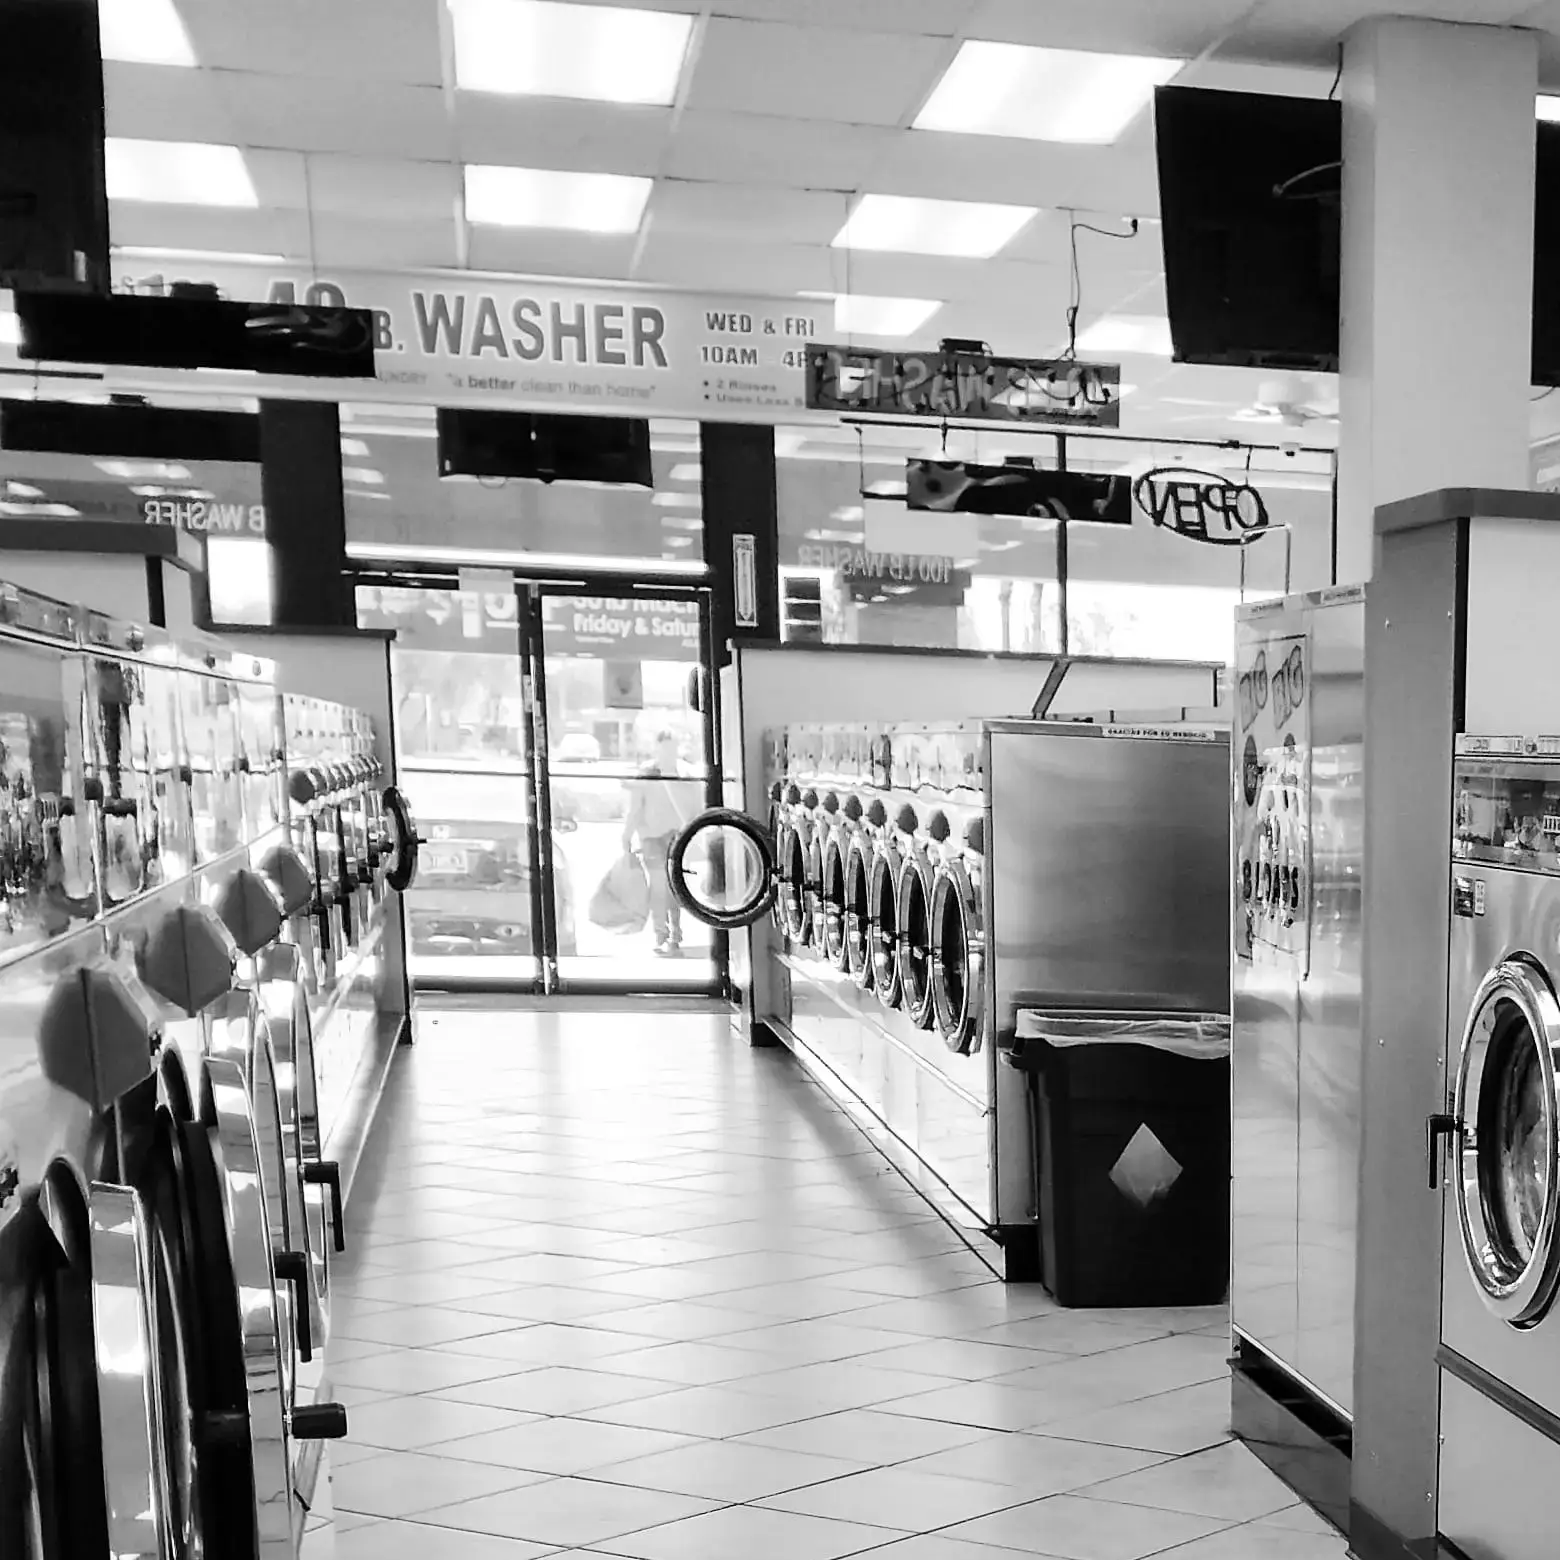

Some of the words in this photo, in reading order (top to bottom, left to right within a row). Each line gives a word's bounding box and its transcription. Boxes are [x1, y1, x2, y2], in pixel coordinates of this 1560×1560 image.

[372, 310, 404, 350] B.
[412, 291, 669, 368] WASHER
[706, 311, 752, 333] WED
[764, 318, 776, 335] &
[785, 317, 814, 337] FRI
[702, 346, 758, 366] 10AM
[468, 374, 516, 392] better
[521, 378, 563, 394] clean
[568, 379, 601, 397] than
[573, 613, 632, 638] Friday
[635, 616, 649, 635] &
